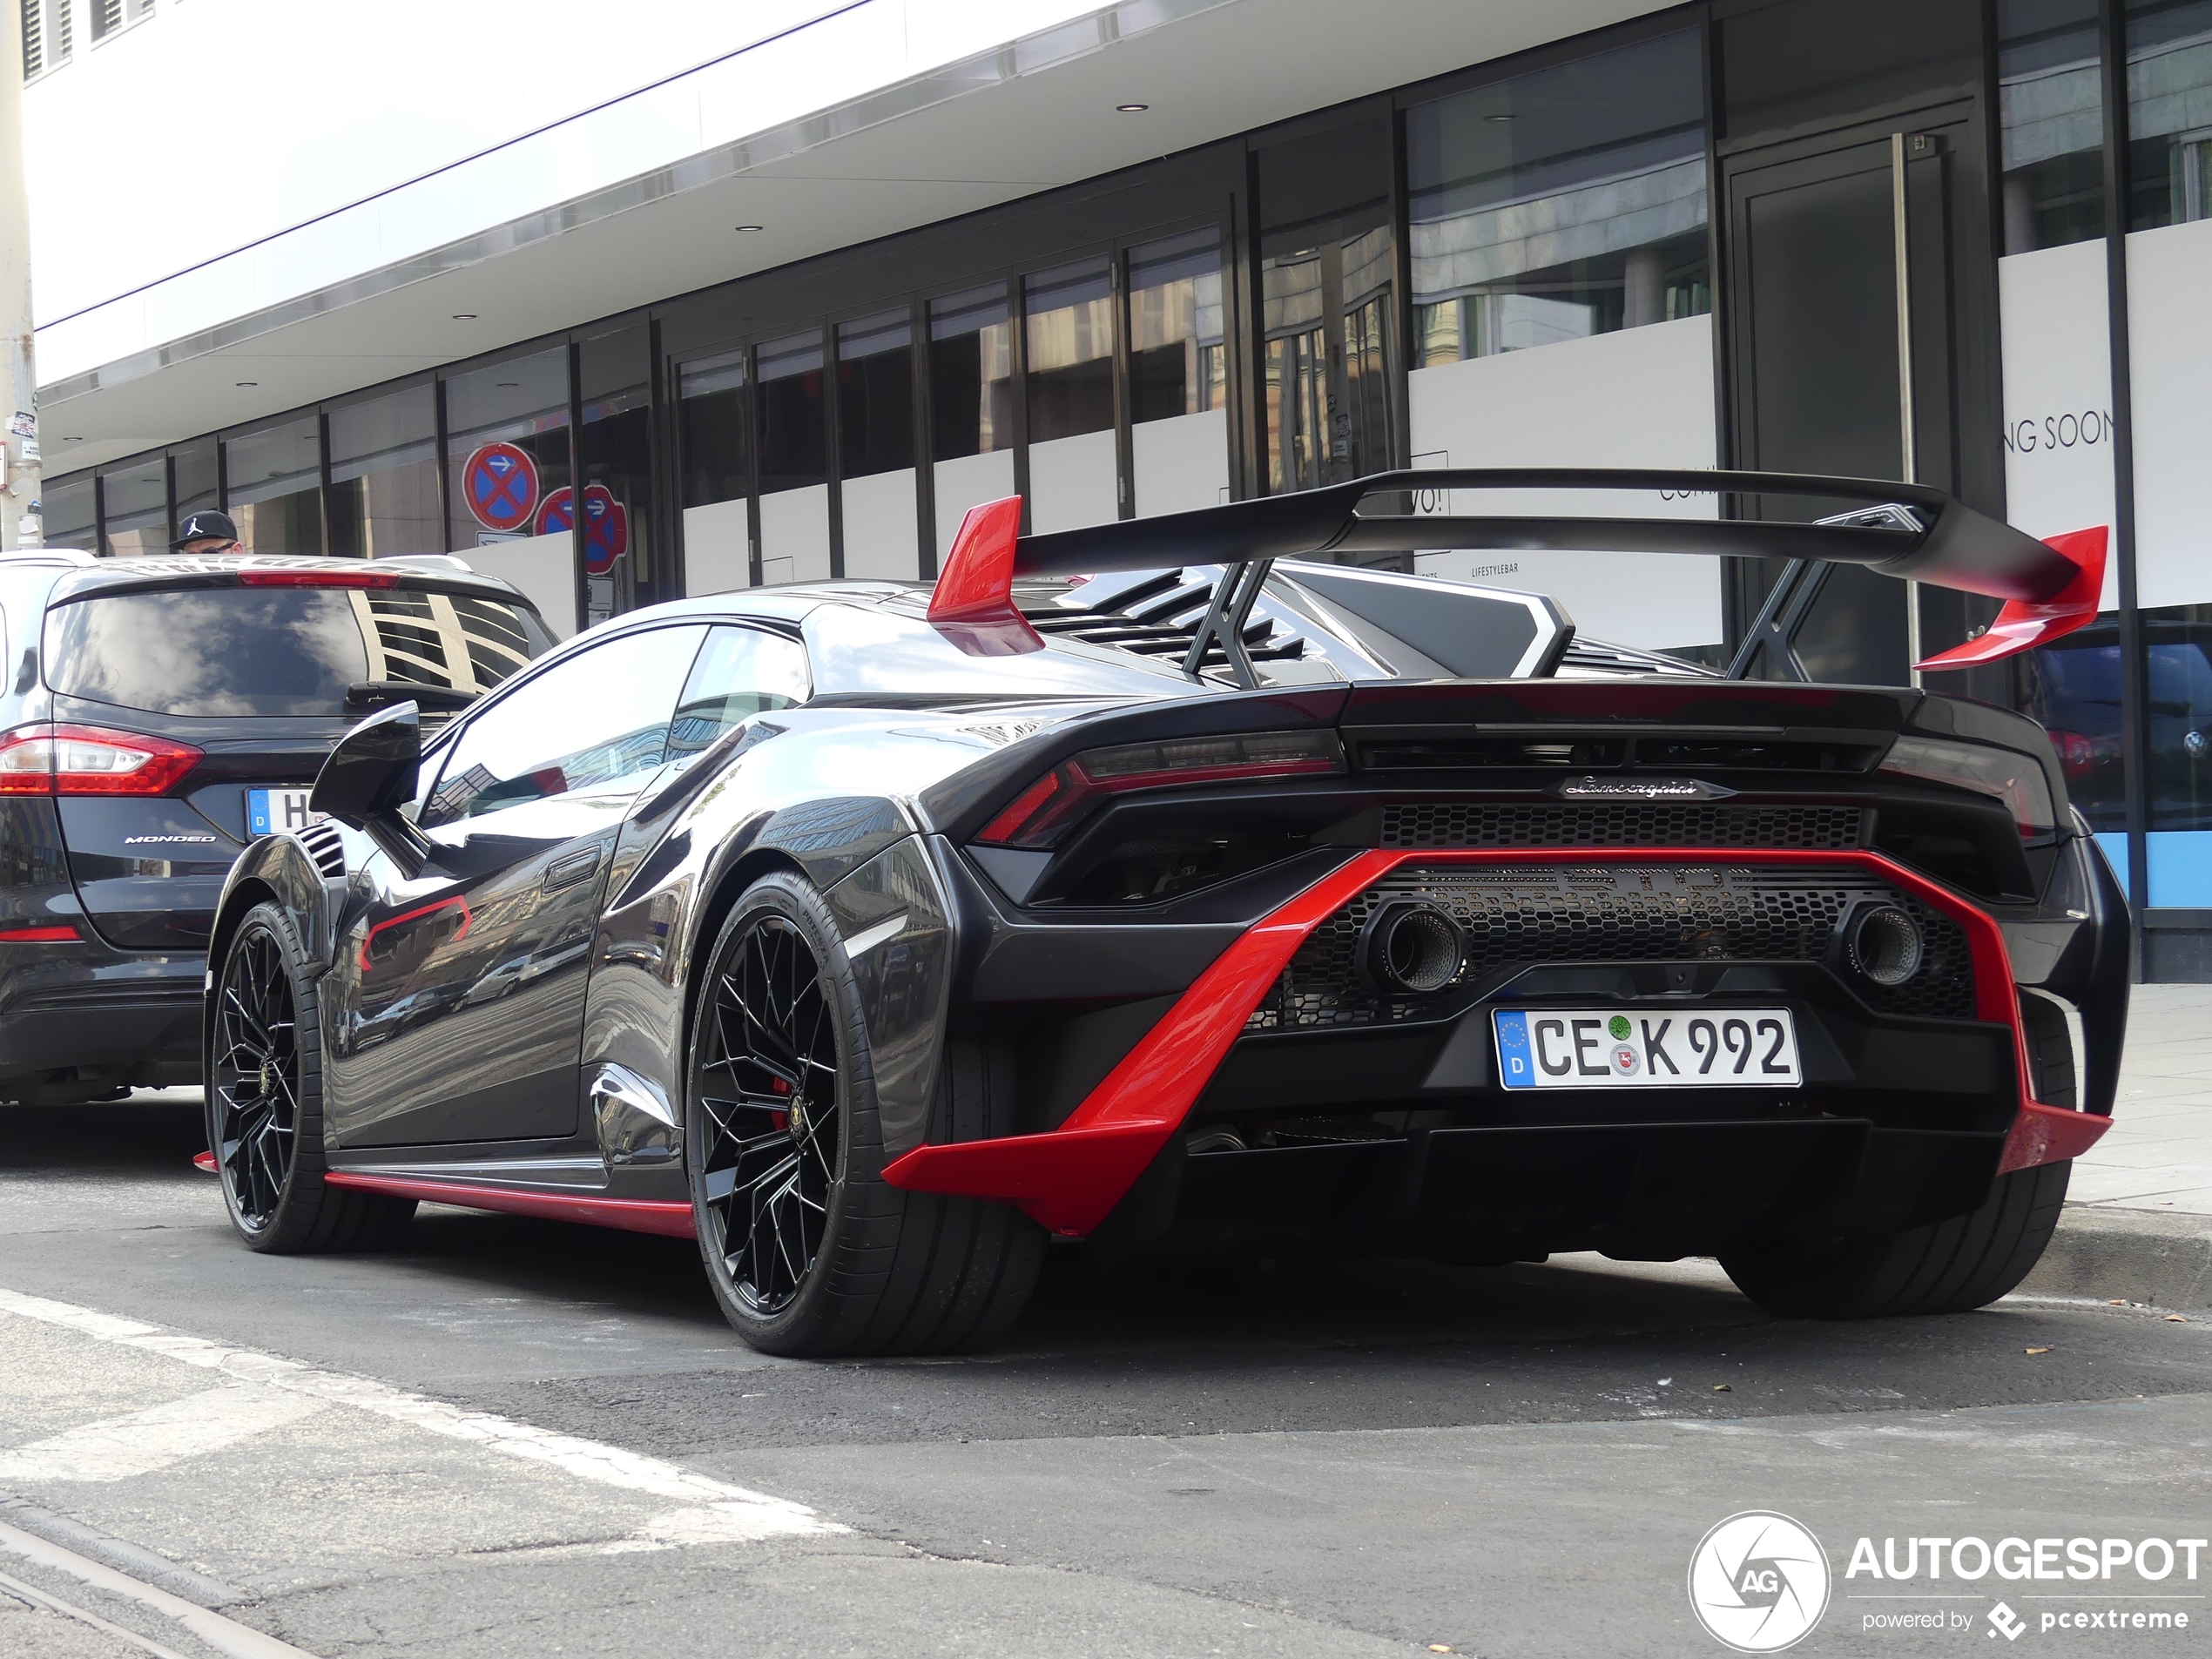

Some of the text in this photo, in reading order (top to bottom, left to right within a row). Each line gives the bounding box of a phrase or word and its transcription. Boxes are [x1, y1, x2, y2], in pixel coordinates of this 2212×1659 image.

[2044, 409, 2114, 450] SOON
[1471, 563, 1519, 578] LIFESTYLEBAR
[284, 793, 308, 828] H
[256, 816, 265, 826] D
[124, 835, 217, 845] MONDEO
[1534, 1018, 1791, 1076] CE K 992
[1511, 1056, 1524, 1074] D
